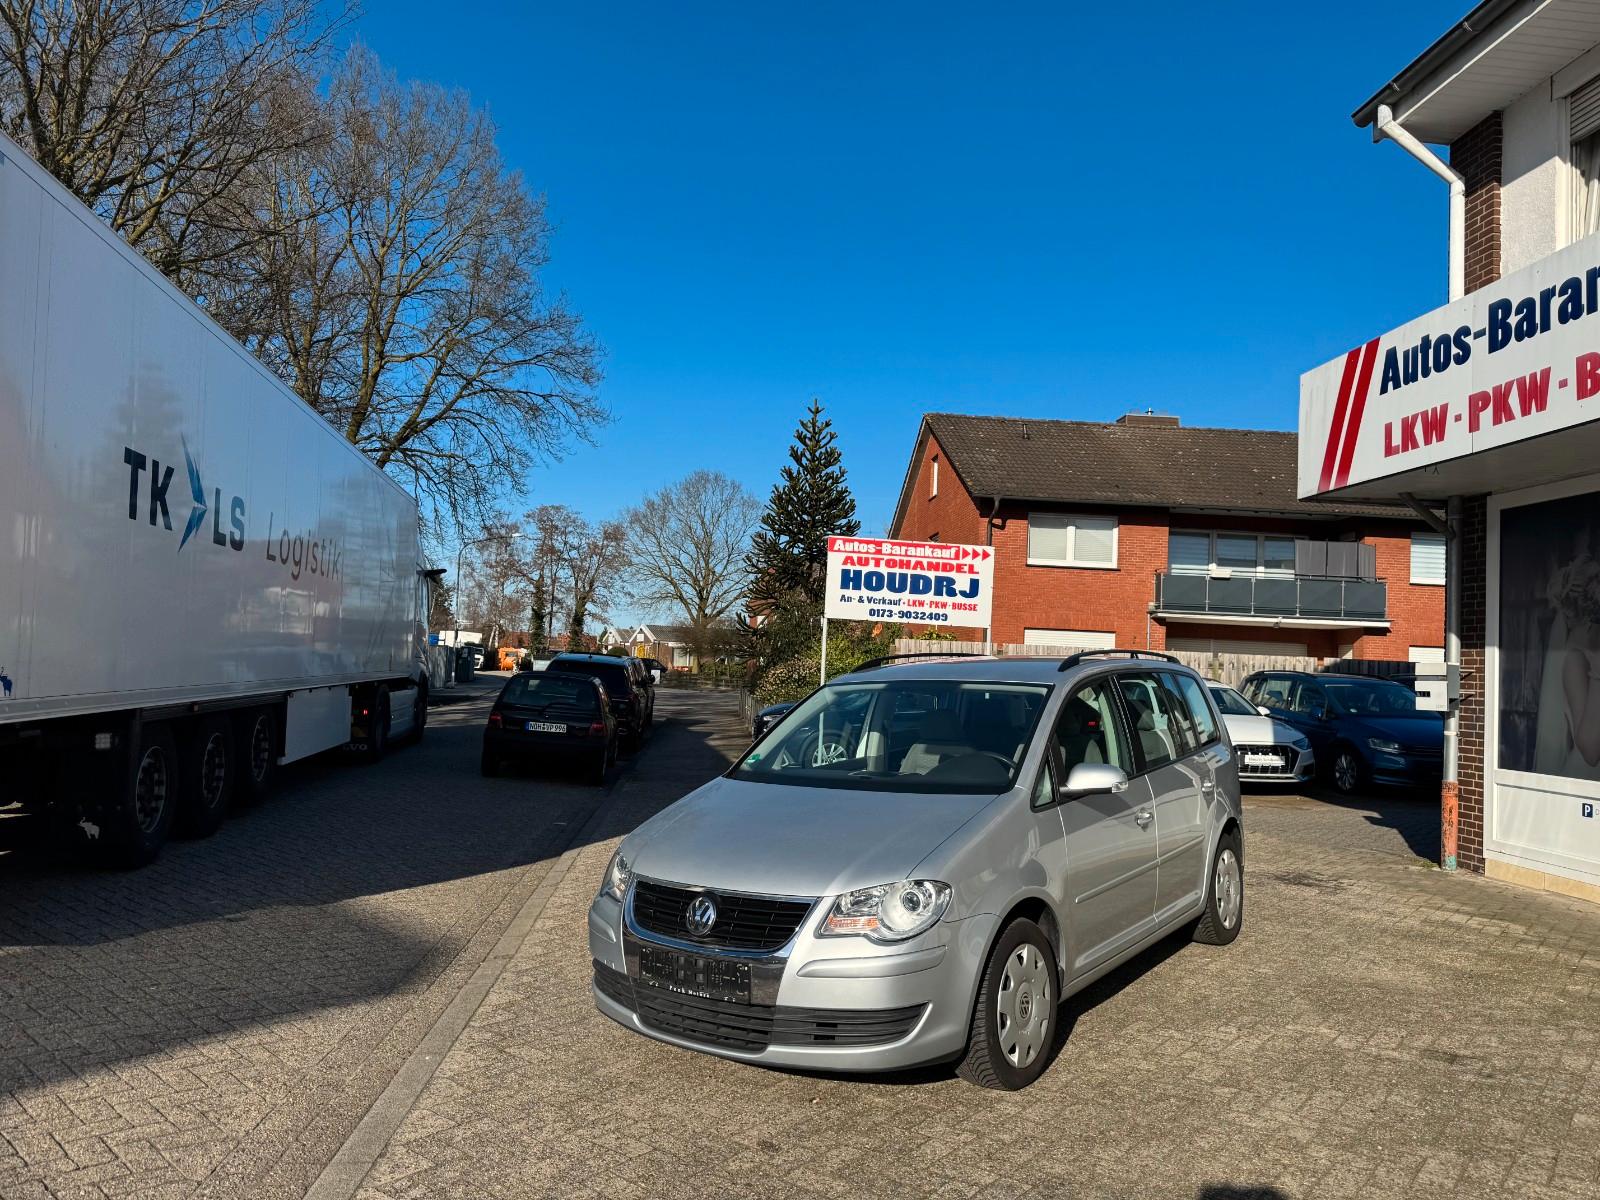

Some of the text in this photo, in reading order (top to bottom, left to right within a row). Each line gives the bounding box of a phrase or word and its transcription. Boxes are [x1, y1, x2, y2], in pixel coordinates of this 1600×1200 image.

[1384, 403, 1449, 458] LKW
[1468, 366, 1551, 433] PKW
[266, 512, 341, 581] Logistik
[833, 539, 958, 559] Autos-Barankauf
[841, 555, 980, 574] AUTOHANDEL
[840, 568, 980, 599] HOUDRJ
[867, 595, 902, 606] Verkauf
[907, 598, 925, 608] LKW
[929, 601, 948, 609] PKW
[951, 602, 978, 612] BUSSE
[868, 608, 948, 622] 0173-9032409
